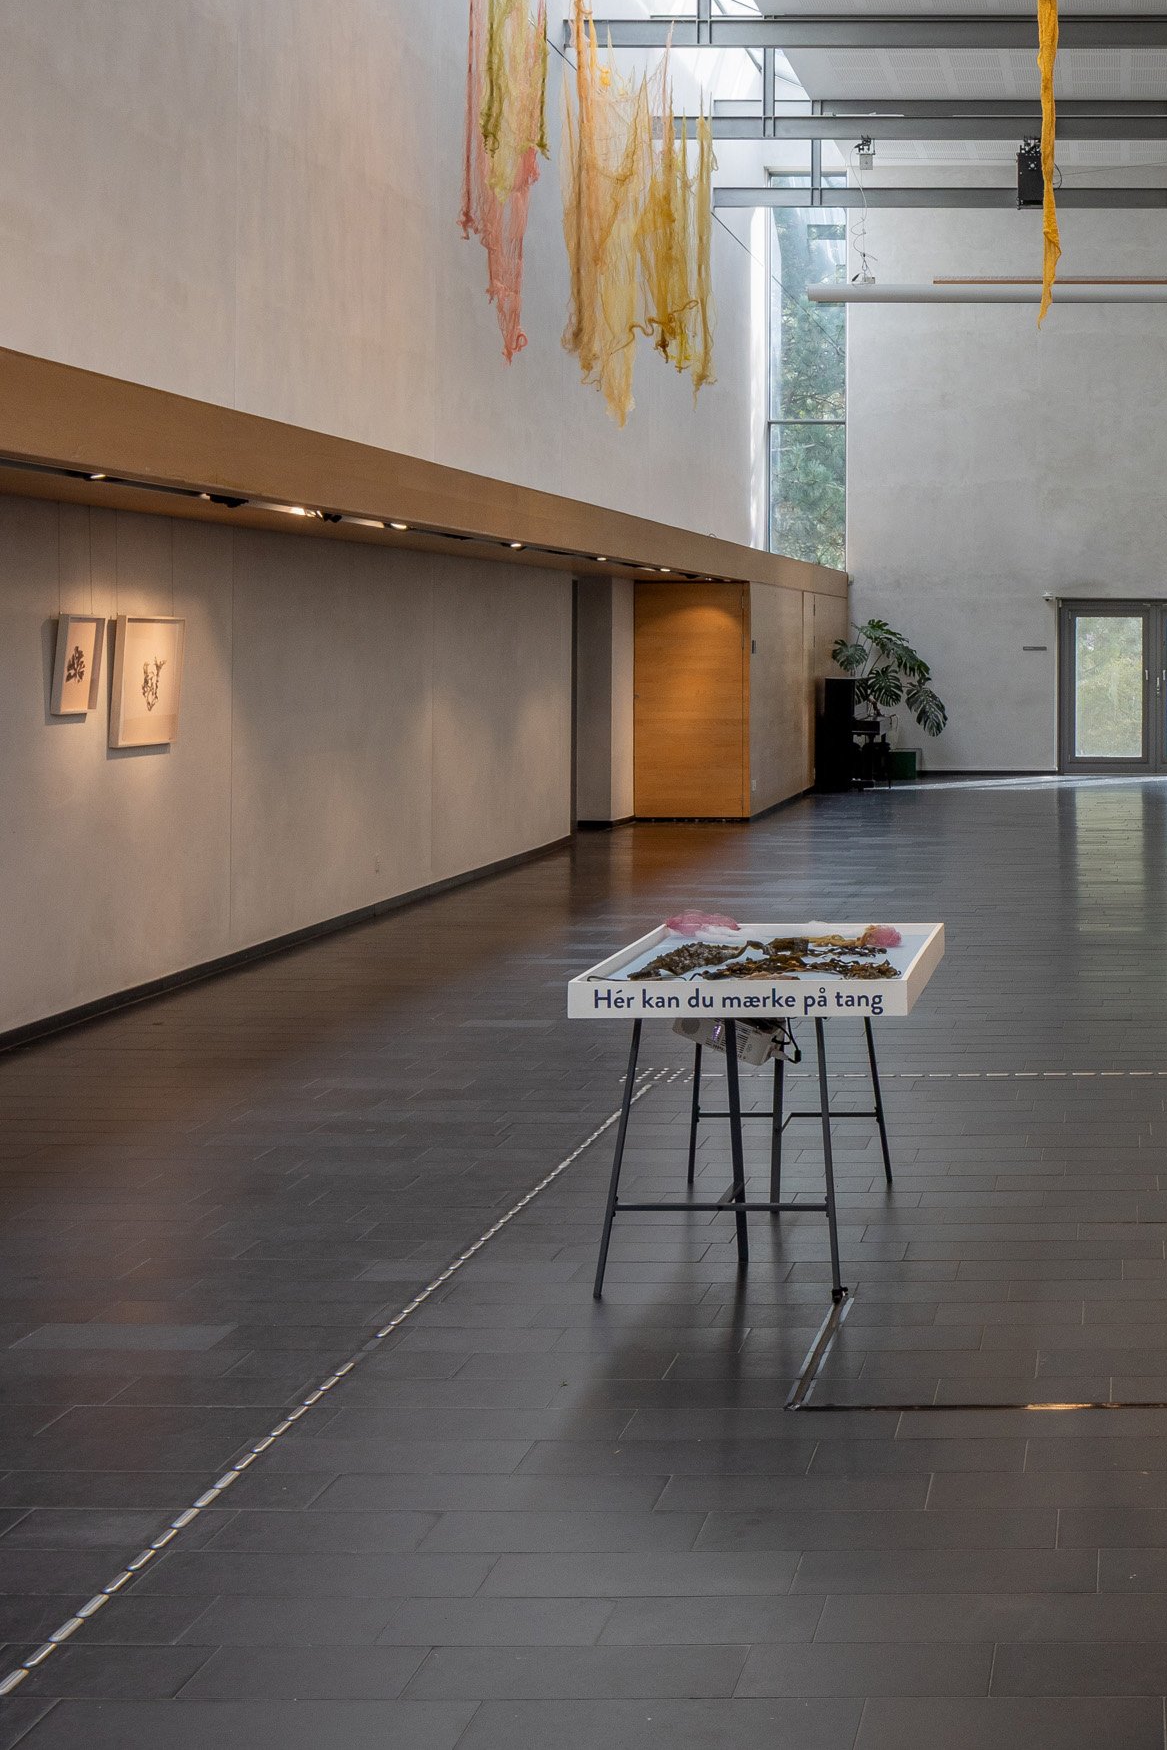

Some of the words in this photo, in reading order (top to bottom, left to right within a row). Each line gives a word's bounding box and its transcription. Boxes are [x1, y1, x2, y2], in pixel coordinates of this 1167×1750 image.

[593, 988, 635, 1009] Hér
[642, 988, 680, 1009] kan
[687, 988, 714, 1009] du
[721, 988, 796, 1009] mærke
[803, 987, 828, 1016] på
[834, 990, 884, 1015] tang
